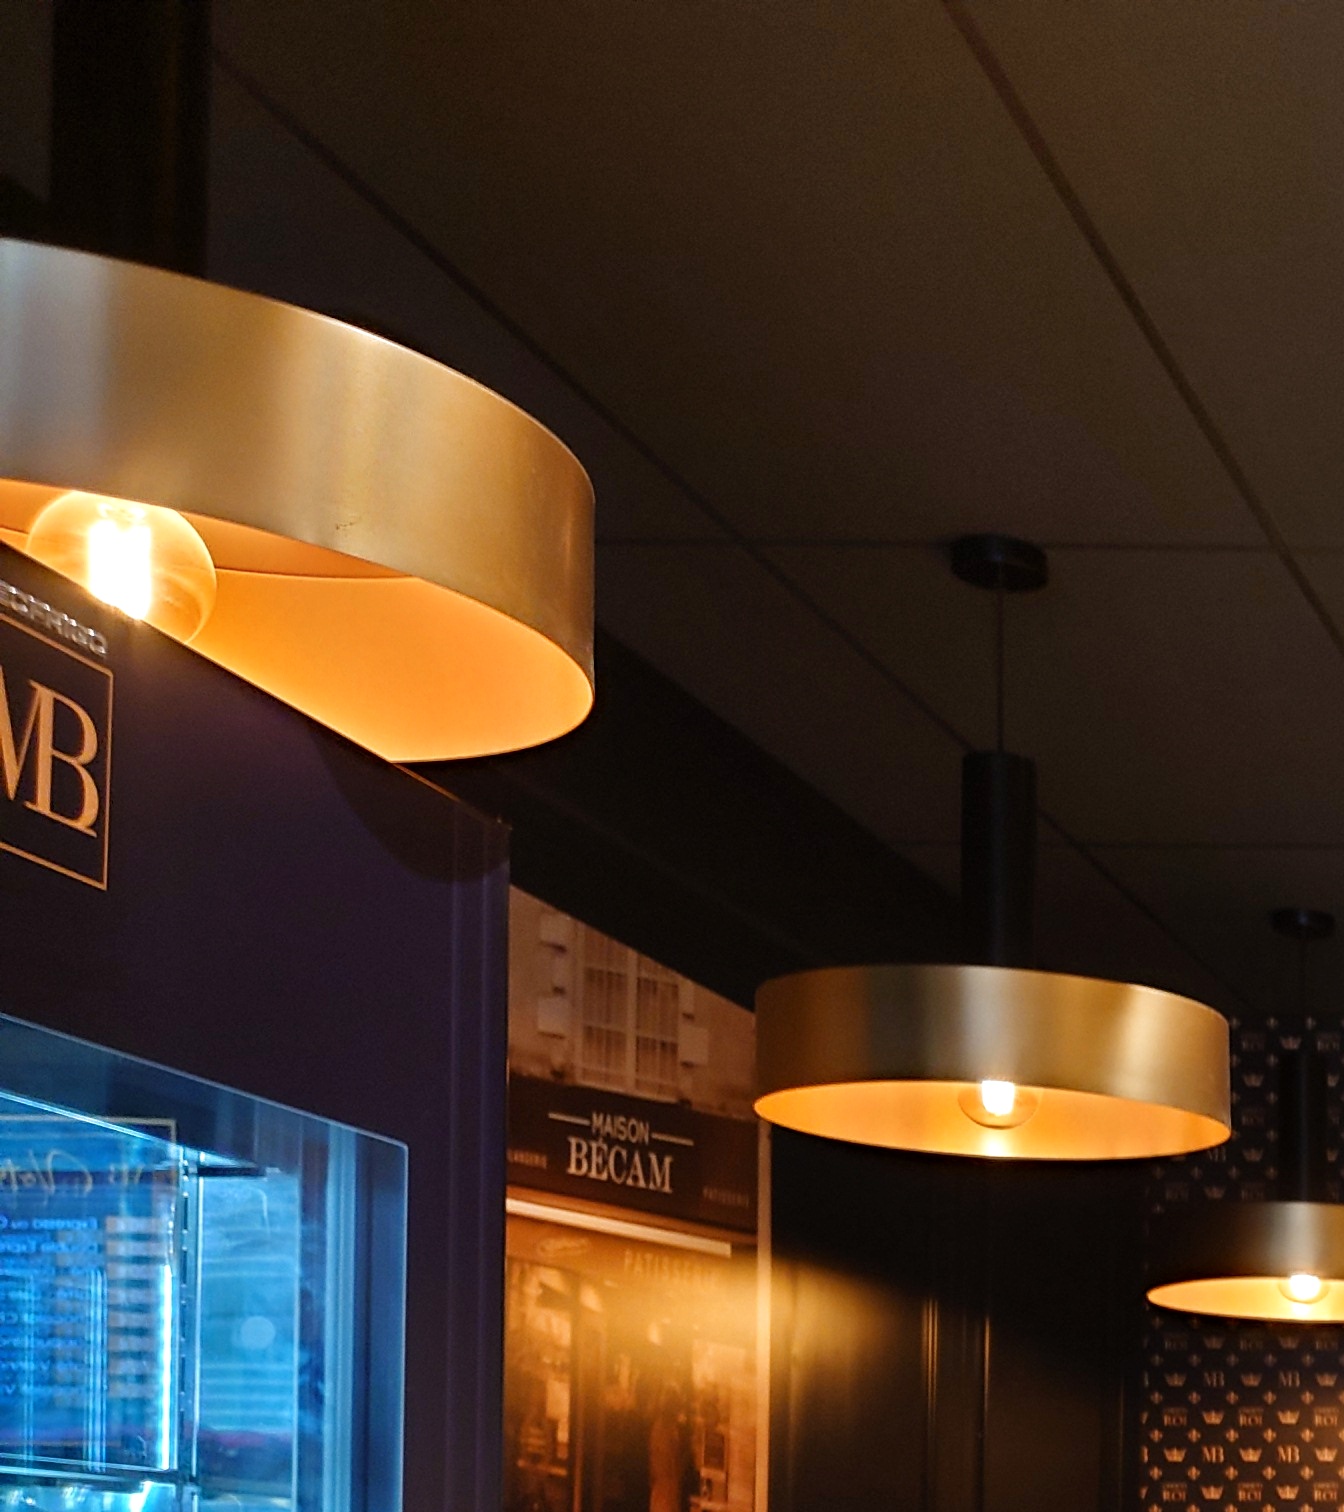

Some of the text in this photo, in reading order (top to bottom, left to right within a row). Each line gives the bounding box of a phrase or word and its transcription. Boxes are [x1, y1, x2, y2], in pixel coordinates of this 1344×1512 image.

[0, 664, 99, 838] MB
[590, 1111, 650, 1146] MAISON
[566, 1136, 674, 1194] BÉCAM
[1279, 1371, 1301, 1388] MB
